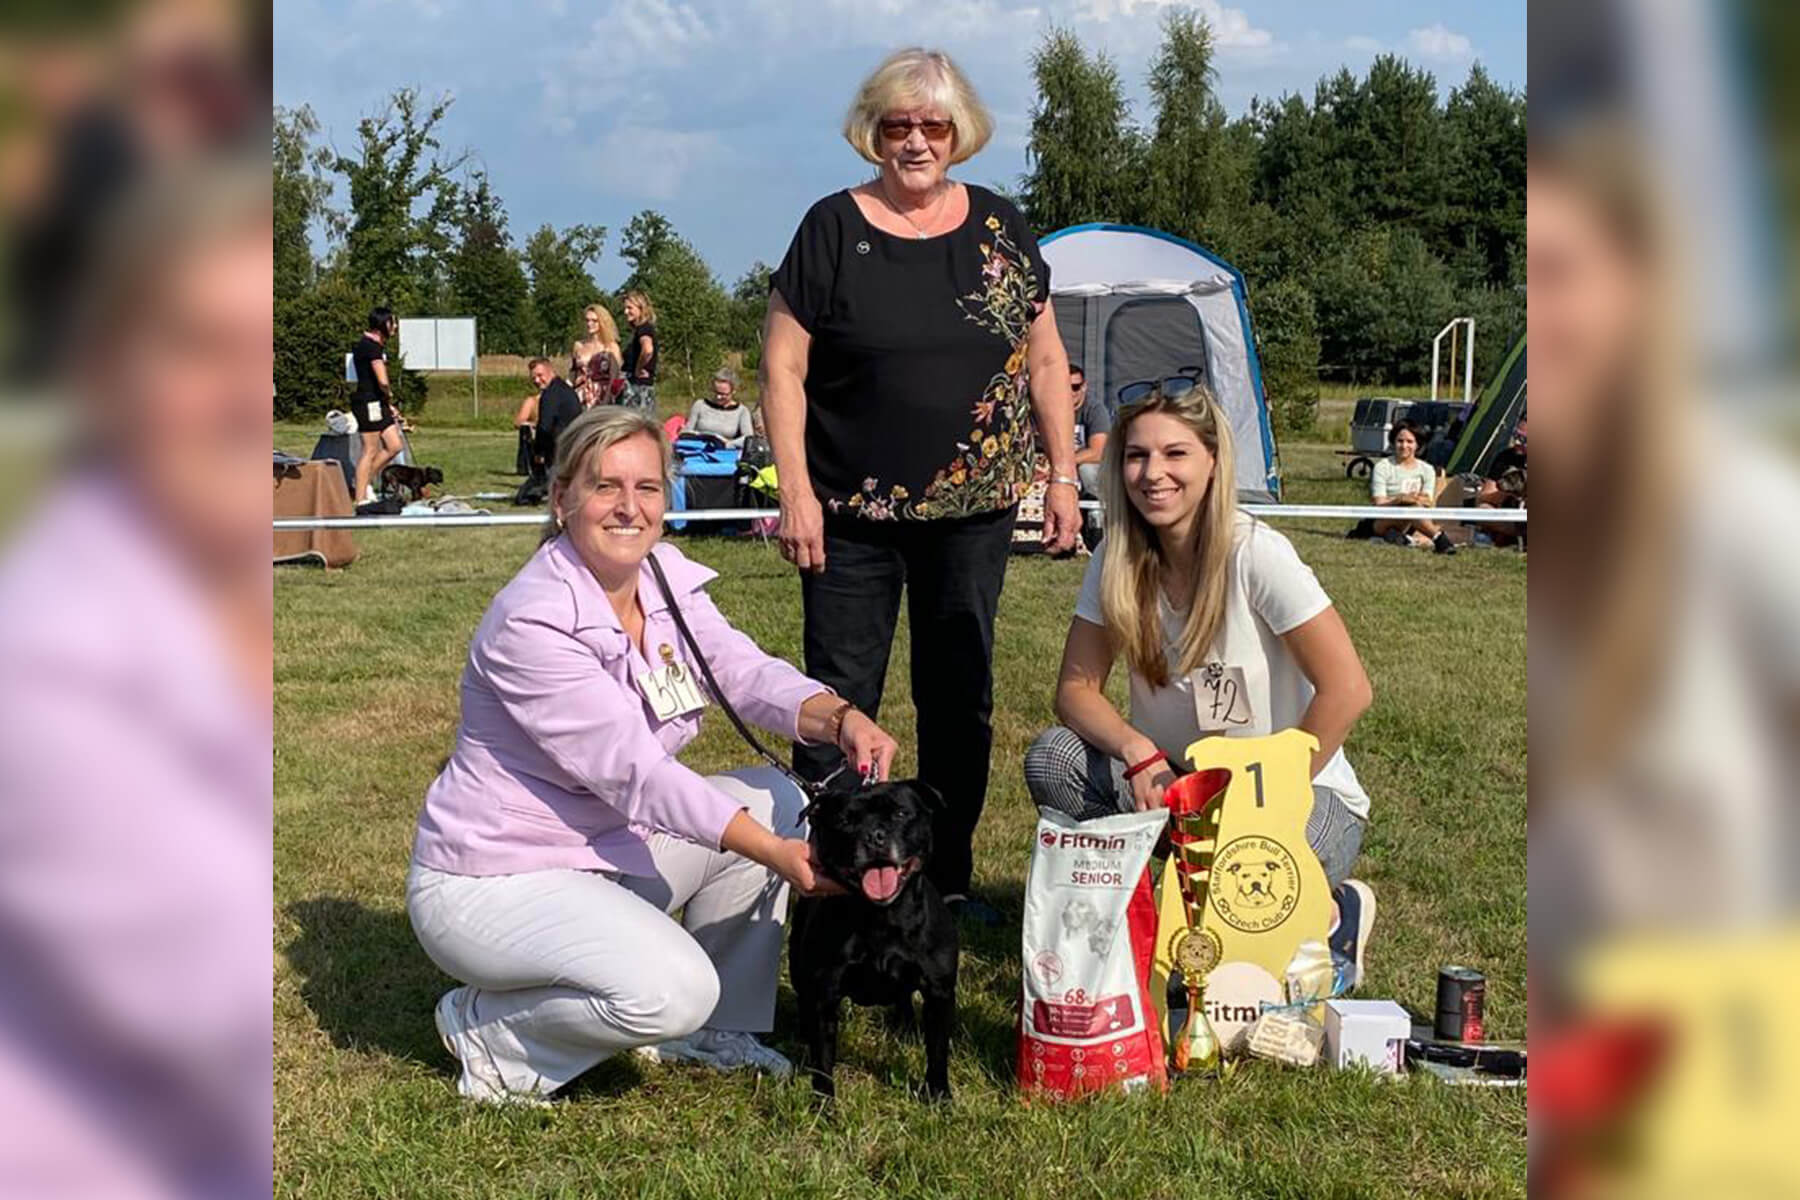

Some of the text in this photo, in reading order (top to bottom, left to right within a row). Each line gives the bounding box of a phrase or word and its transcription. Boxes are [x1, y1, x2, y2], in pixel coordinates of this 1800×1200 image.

[1204, 679, 1249, 725] 72
[1245, 761, 1264, 808] 1
[1060, 832, 1126, 850] Fitmin
[1073, 859, 1122, 871] MEDIUM
[1212, 840, 1295, 895] Staffordshire Bull Terrier
[1071, 871, 1123, 885] SENIOR
[1228, 911, 1284, 929] Czech Club
